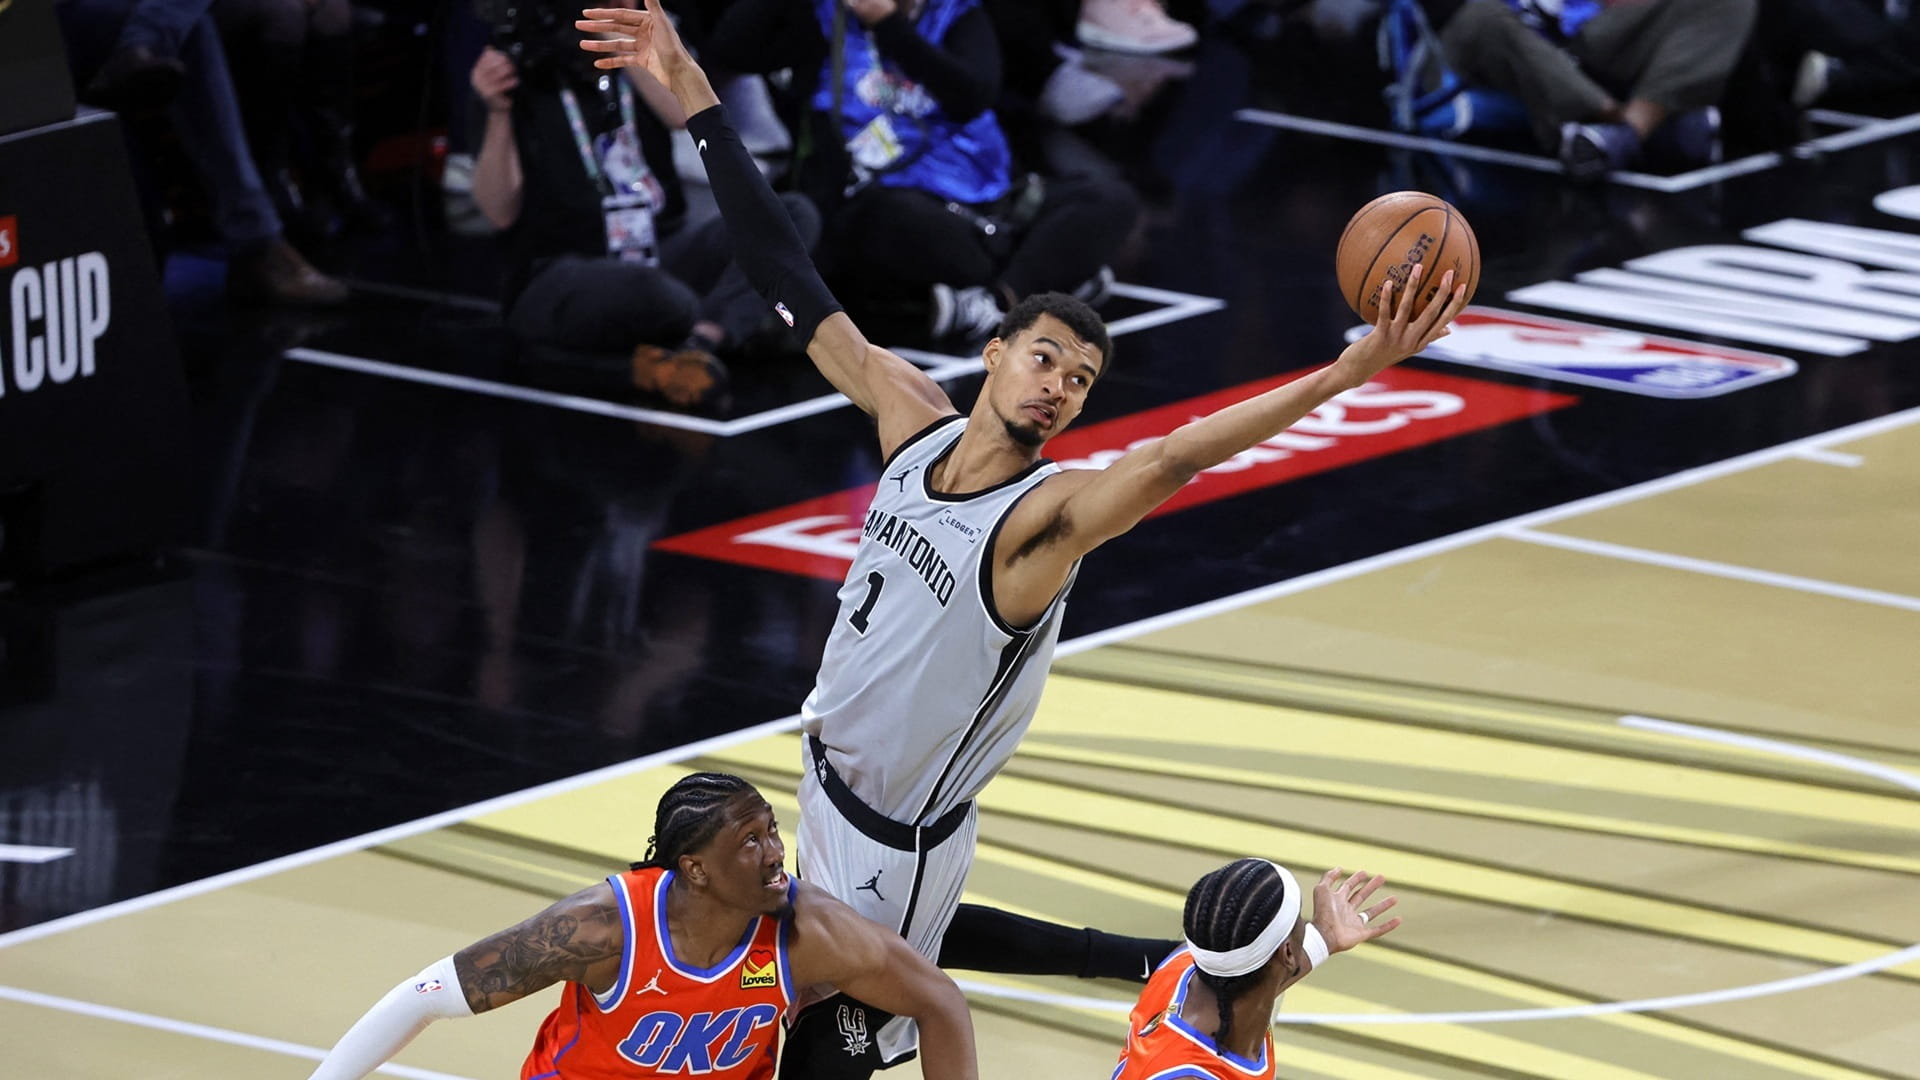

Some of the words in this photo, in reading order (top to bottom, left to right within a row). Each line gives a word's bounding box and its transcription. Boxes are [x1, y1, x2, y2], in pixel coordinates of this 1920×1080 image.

[10, 251, 110, 392] CUP
[875, 514, 957, 609] ANTONIO
[945, 516, 975, 538] LEDGER
[848, 570, 885, 636] 1
[616, 1003, 778, 1076] OKC
